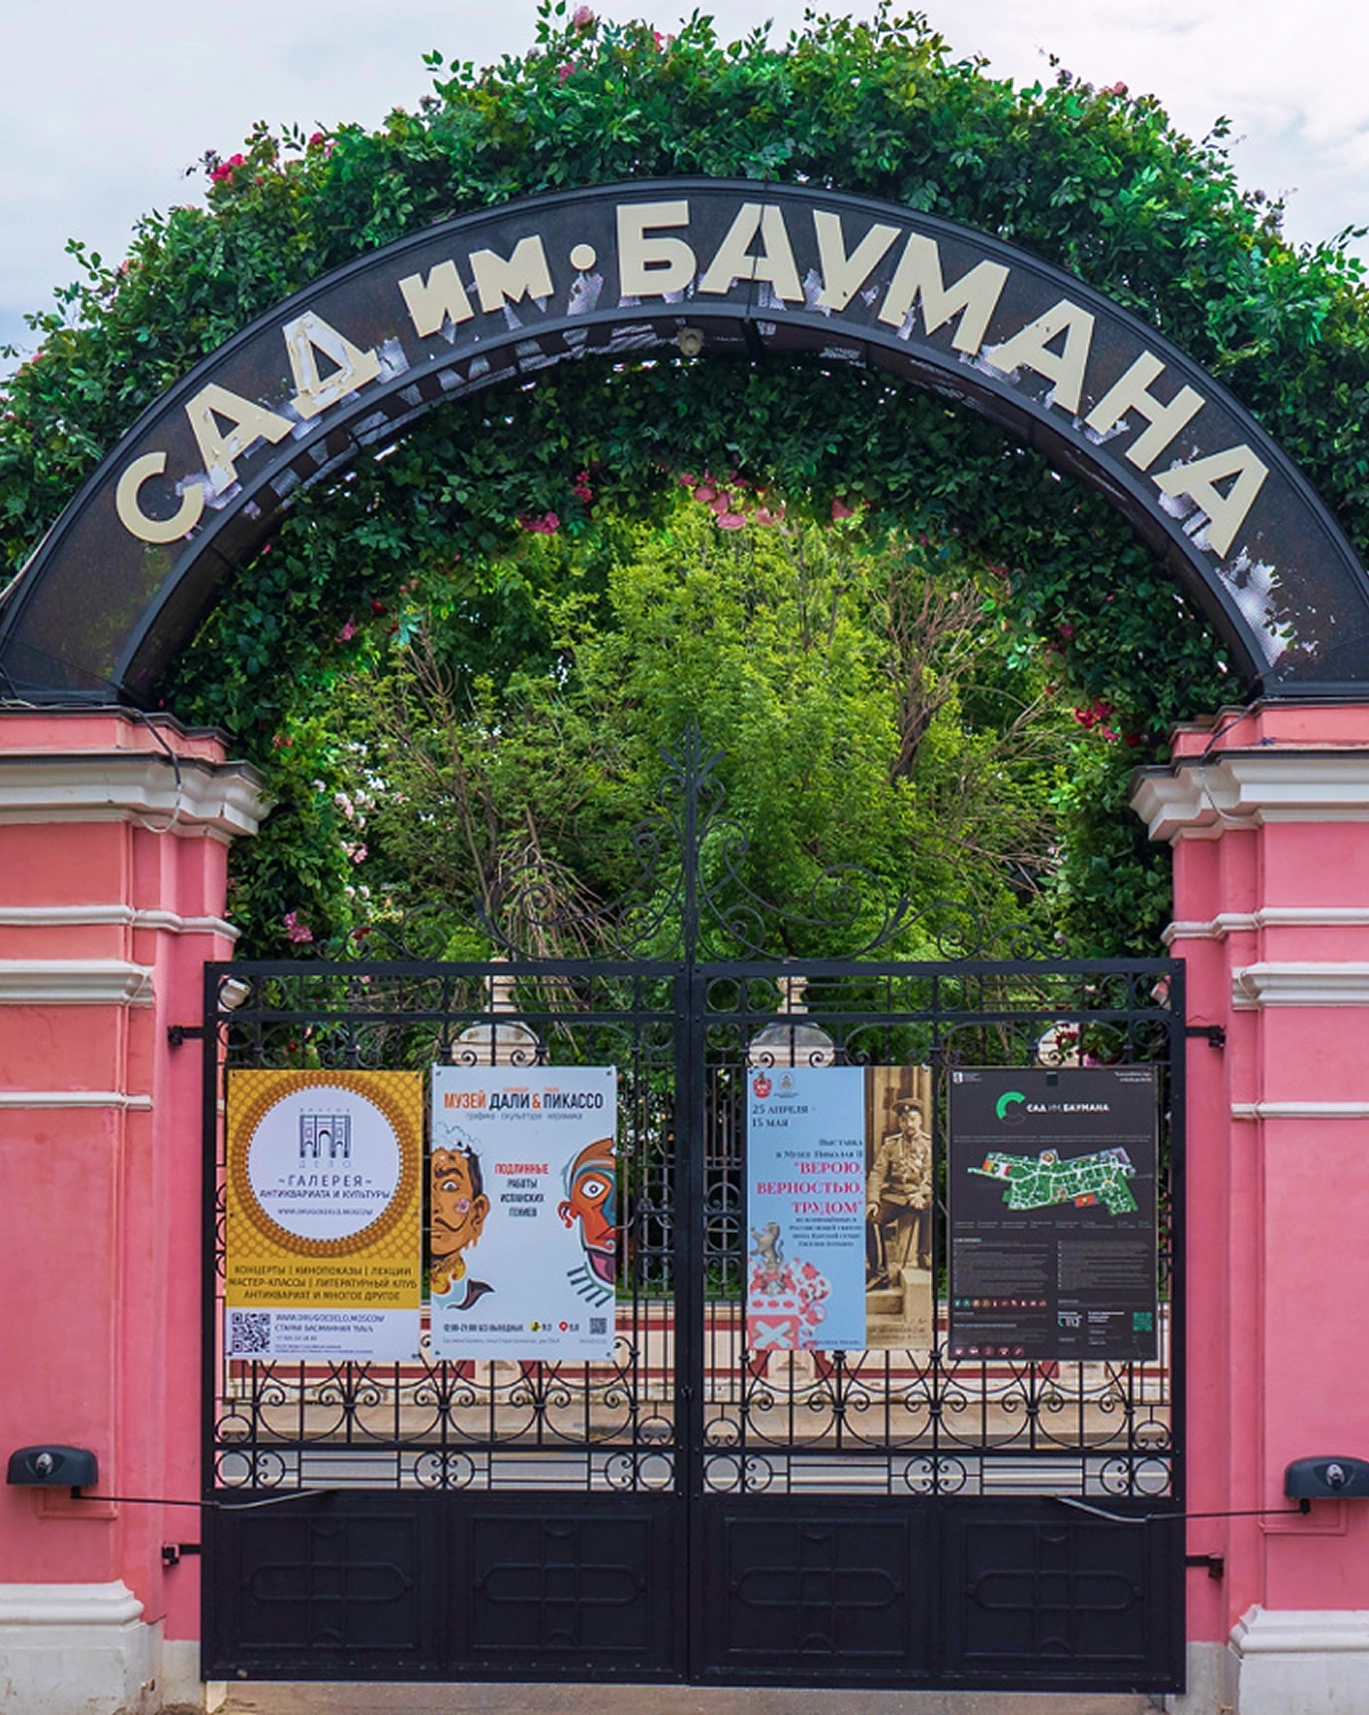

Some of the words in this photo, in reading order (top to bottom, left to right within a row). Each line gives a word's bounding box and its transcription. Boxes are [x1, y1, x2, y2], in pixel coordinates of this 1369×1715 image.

[115, 310, 383, 544] САД
[616, 199, 1269, 560] БАУМАНА
[444, 1090, 486, 1109] МУЗЕЙ
[489, 1093, 530, 1111] ДАЛИ
[532, 1093, 542, 1109] &
[543, 1093, 604, 1109] ПИКАССО
[752, 1104, 765, 1115] 25
[1026, 1104, 1046, 1113] САД
[1063, 1104, 1110, 1113] БАУМАНА
[752, 1118, 764, 1128] 15
[495, 1163, 549, 1175] ПОДЛИННЫЕ
[507, 1178, 538, 1189] РАБОТЫ
[259, 1189, 330, 1199] АНТИКВАРИАТА
[333, 1190, 340, 1199] И
[342, 1190, 391, 1199] КУЛЬТУРЫ
[500, 1194, 544, 1203] ИСПАНСКИХ
[508, 1207, 538, 1217] ГЕНИЕВ
[234, 1266, 286, 1276] КОНЦЕРТЫ
[295, 1266, 363, 1276] КИНОПОКАЗЫ
[371, 1267, 412, 1276] ЛЕКЦИИ
[229, 1278, 306, 1287] МАСТЕР-КЛАССЫ
[315, 1278, 390, 1289] ЛИТЕРАТУРНЫЙ
[392, 1280, 418, 1289] КЛУБ
[244, 1291, 310, 1300] АНТИКВАРИАТ
[313, 1291, 321, 1300] И
[323, 1291, 362, 1301] МНОГОЕ
[364, 1291, 400, 1301] ДРУГОЕ
